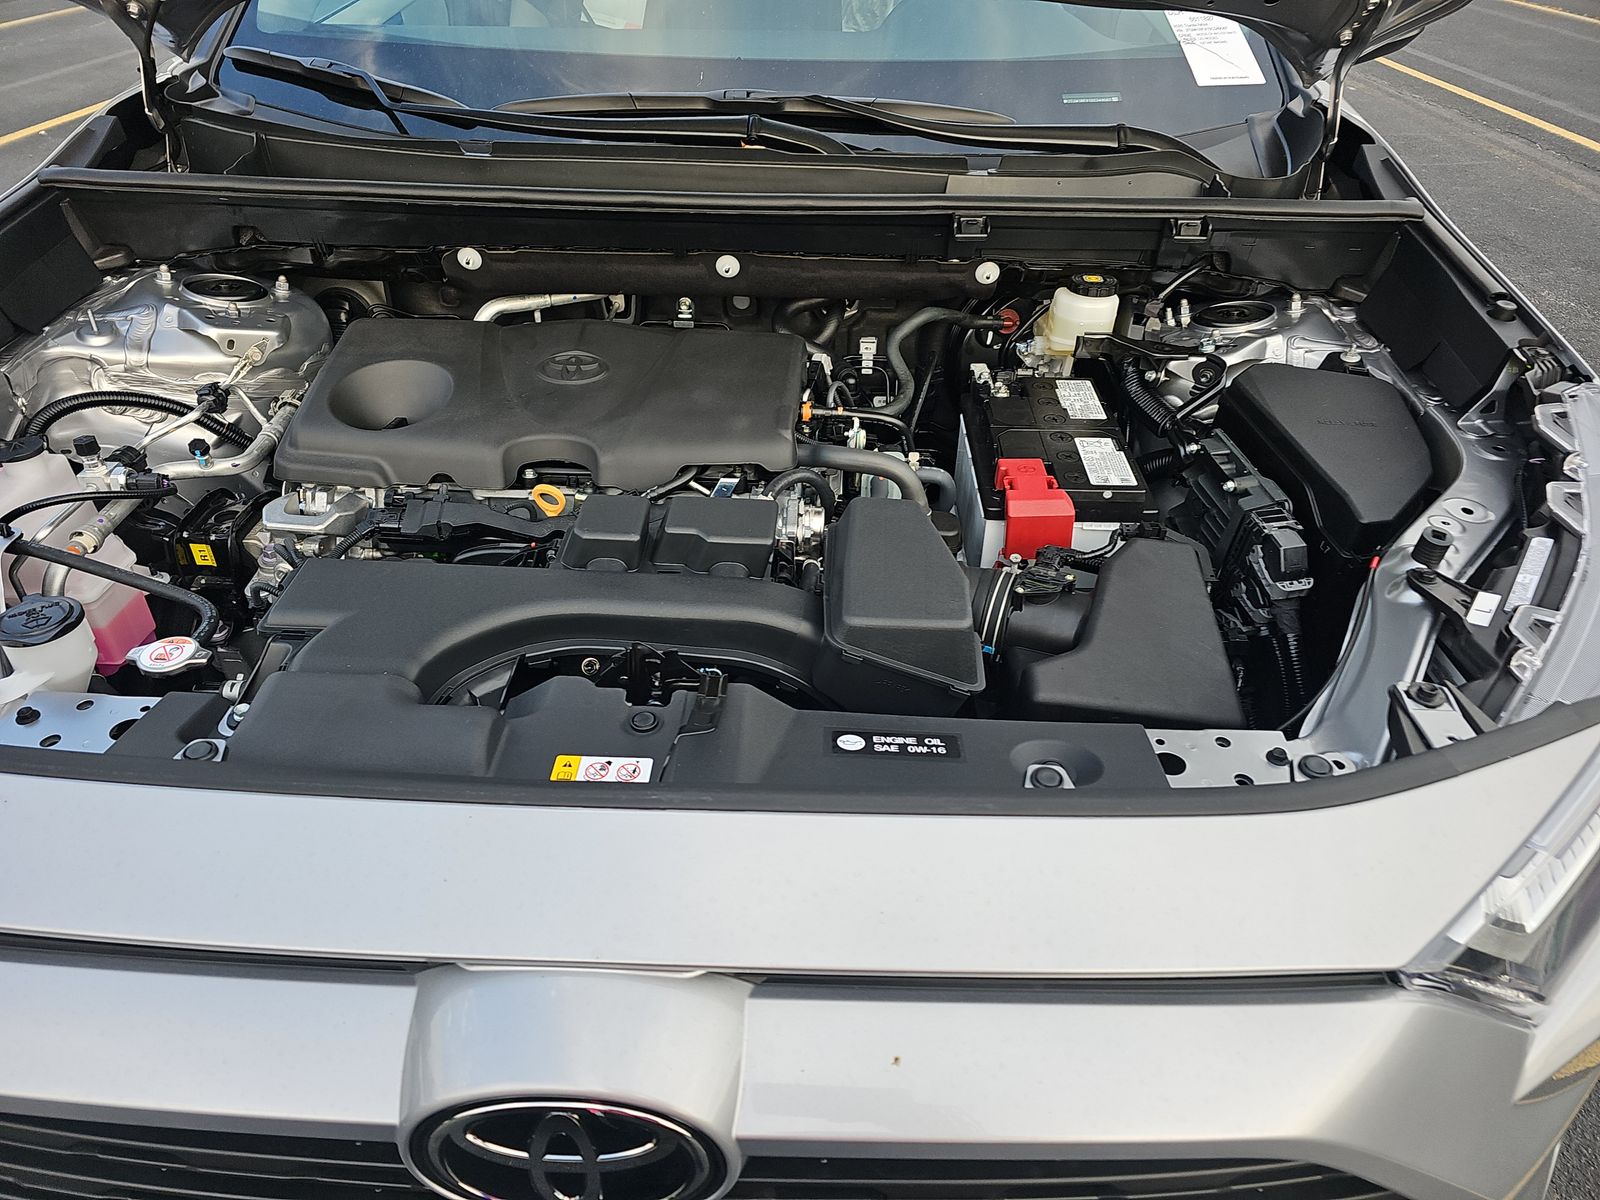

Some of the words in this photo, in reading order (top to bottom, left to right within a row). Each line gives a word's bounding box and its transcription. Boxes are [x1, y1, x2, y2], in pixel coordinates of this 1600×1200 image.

[198, 549, 210, 562] R1
[872, 735, 918, 745] ENGINE
[923, 737, 946, 746] OIL
[873, 744, 900, 753] SAE
[907, 746, 947, 754] 0W-16
